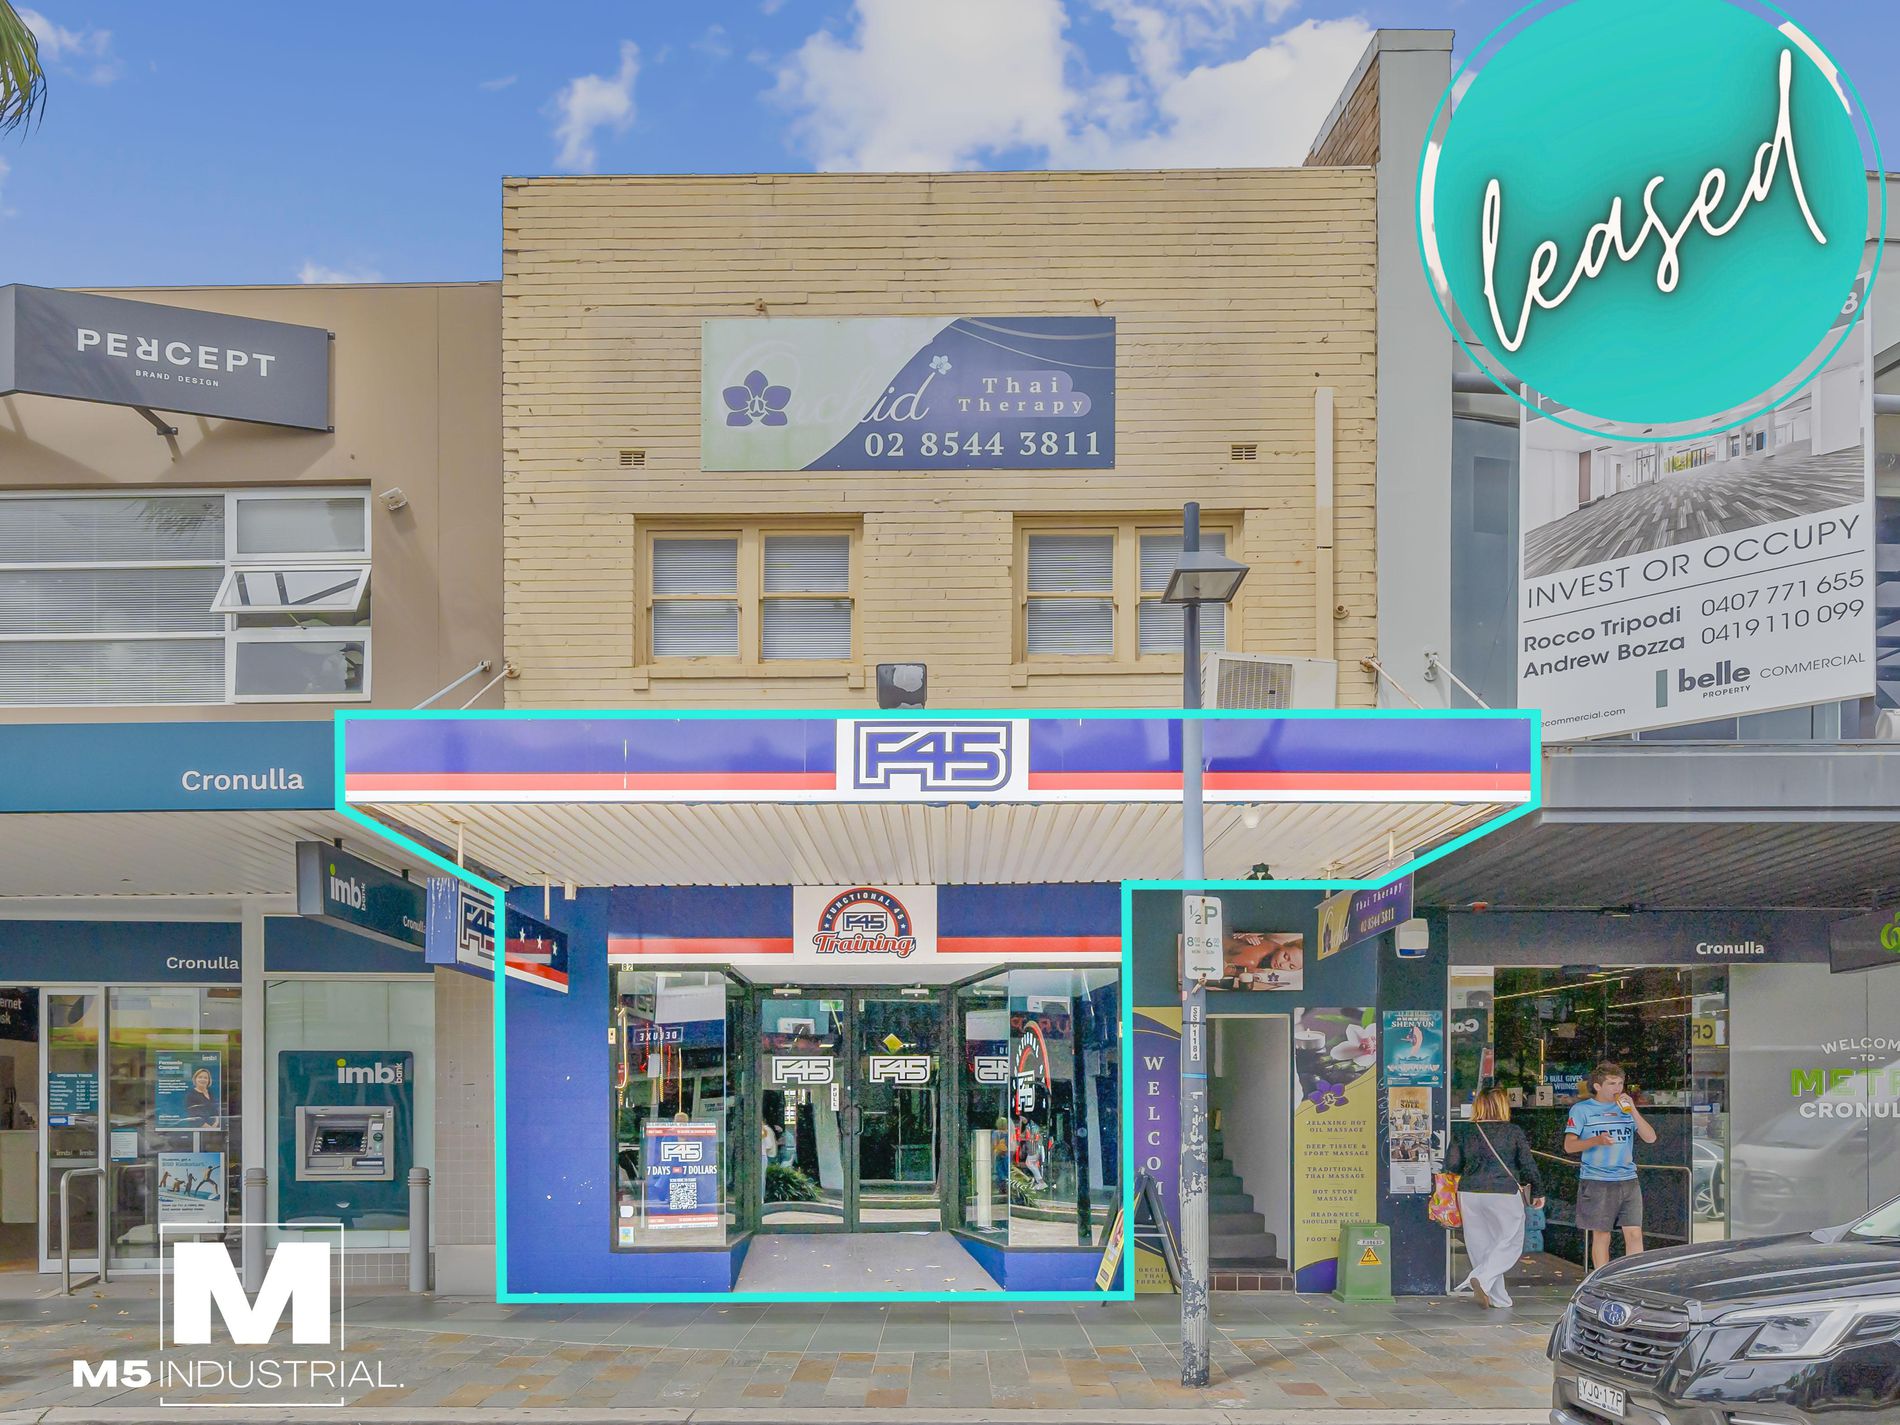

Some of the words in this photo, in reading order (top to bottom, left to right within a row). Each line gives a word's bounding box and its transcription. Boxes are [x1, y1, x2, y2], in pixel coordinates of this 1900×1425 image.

[135, 369, 171, 381] BRAND
[178, 375, 219, 387] DESIGN
[982, 376, 1059, 394] Thai
[958, 398, 1084, 415] Therapy
[864, 433, 905, 457] 02
[920, 431, 1005, 457] 8544
[1019, 431, 1101, 456] 3811
[1528, 566, 1631, 609] INVEST
[1643, 553, 1691, 583] OR
[1703, 514, 1860, 569] OCCUPY
[1701, 589, 1759, 617] 0407
[1766, 580, 1808, 605] 771
[1815, 569, 1865, 595] 655
[1524, 624, 1596, 653] Rocco
[1601, 605, 1682, 637] Tripodi
[1701, 619, 1761, 646] 0419
[1767, 608, 1810, 633] 110
[1816, 599, 1865, 624] 099
[1523, 649, 1609, 679] Andrew
[1617, 634, 1686, 662] Bozza
[1678, 660, 1751, 692] belle
[1759, 653, 1866, 680] COMMERCIAL
[1702, 684, 1752, 699] PROPERTY
[853, 720, 1013, 791] F45
[181, 768, 305, 791] Cronulla
[330, 864, 361, 911] imb
[1356, 896, 1370, 912] Thai
[1373, 882, 1403, 903] Therapy
[826, 892, 890, 920] FUNCTIONAL
[893, 908, 905, 920] 45
[843, 912, 887, 932] F45
[813, 931, 916, 958] Training
[1696, 941, 1765, 955] Cronulla
[166, 957, 240, 971] Cronulla
[336, 1058, 395, 1084] imb
[395, 1062, 403, 1084] bank
[772, 1056, 834, 1084] F45
[870, 1056, 930, 1083] F45
[661, 1142, 703, 1162] F45
[647, 1166, 651, 1175] 7
[652, 1166, 671, 1175] DAYS
[683, 1166, 688, 1175] 7
[688, 1165, 718, 1174] DOLLARS
